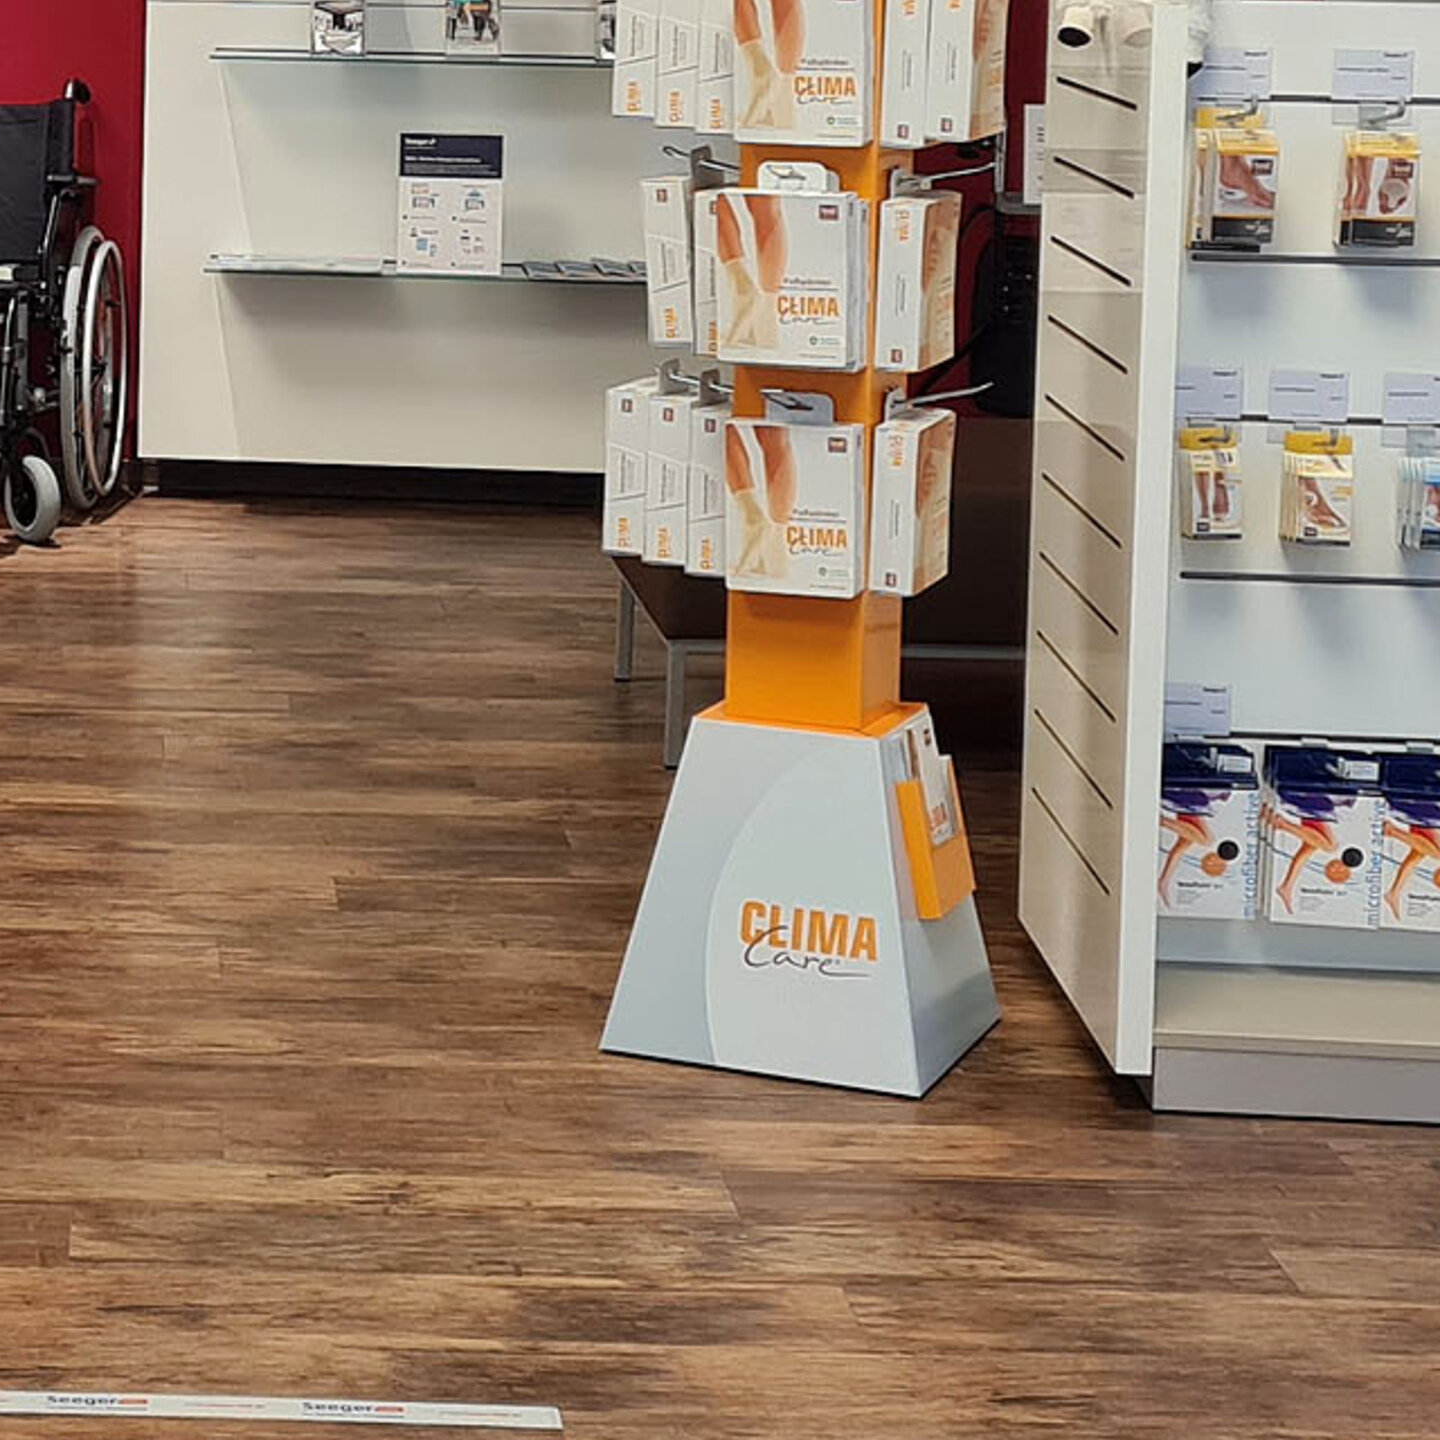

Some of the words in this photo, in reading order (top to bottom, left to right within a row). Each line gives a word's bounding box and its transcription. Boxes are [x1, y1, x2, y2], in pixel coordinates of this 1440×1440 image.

[794, 77, 857, 97] CLIMA
[778, 296, 840, 316] CLIMA
[787, 526, 847, 548] CLIMA
[1244, 793, 1259, 836] active
[741, 900, 877, 961] CLIMA
